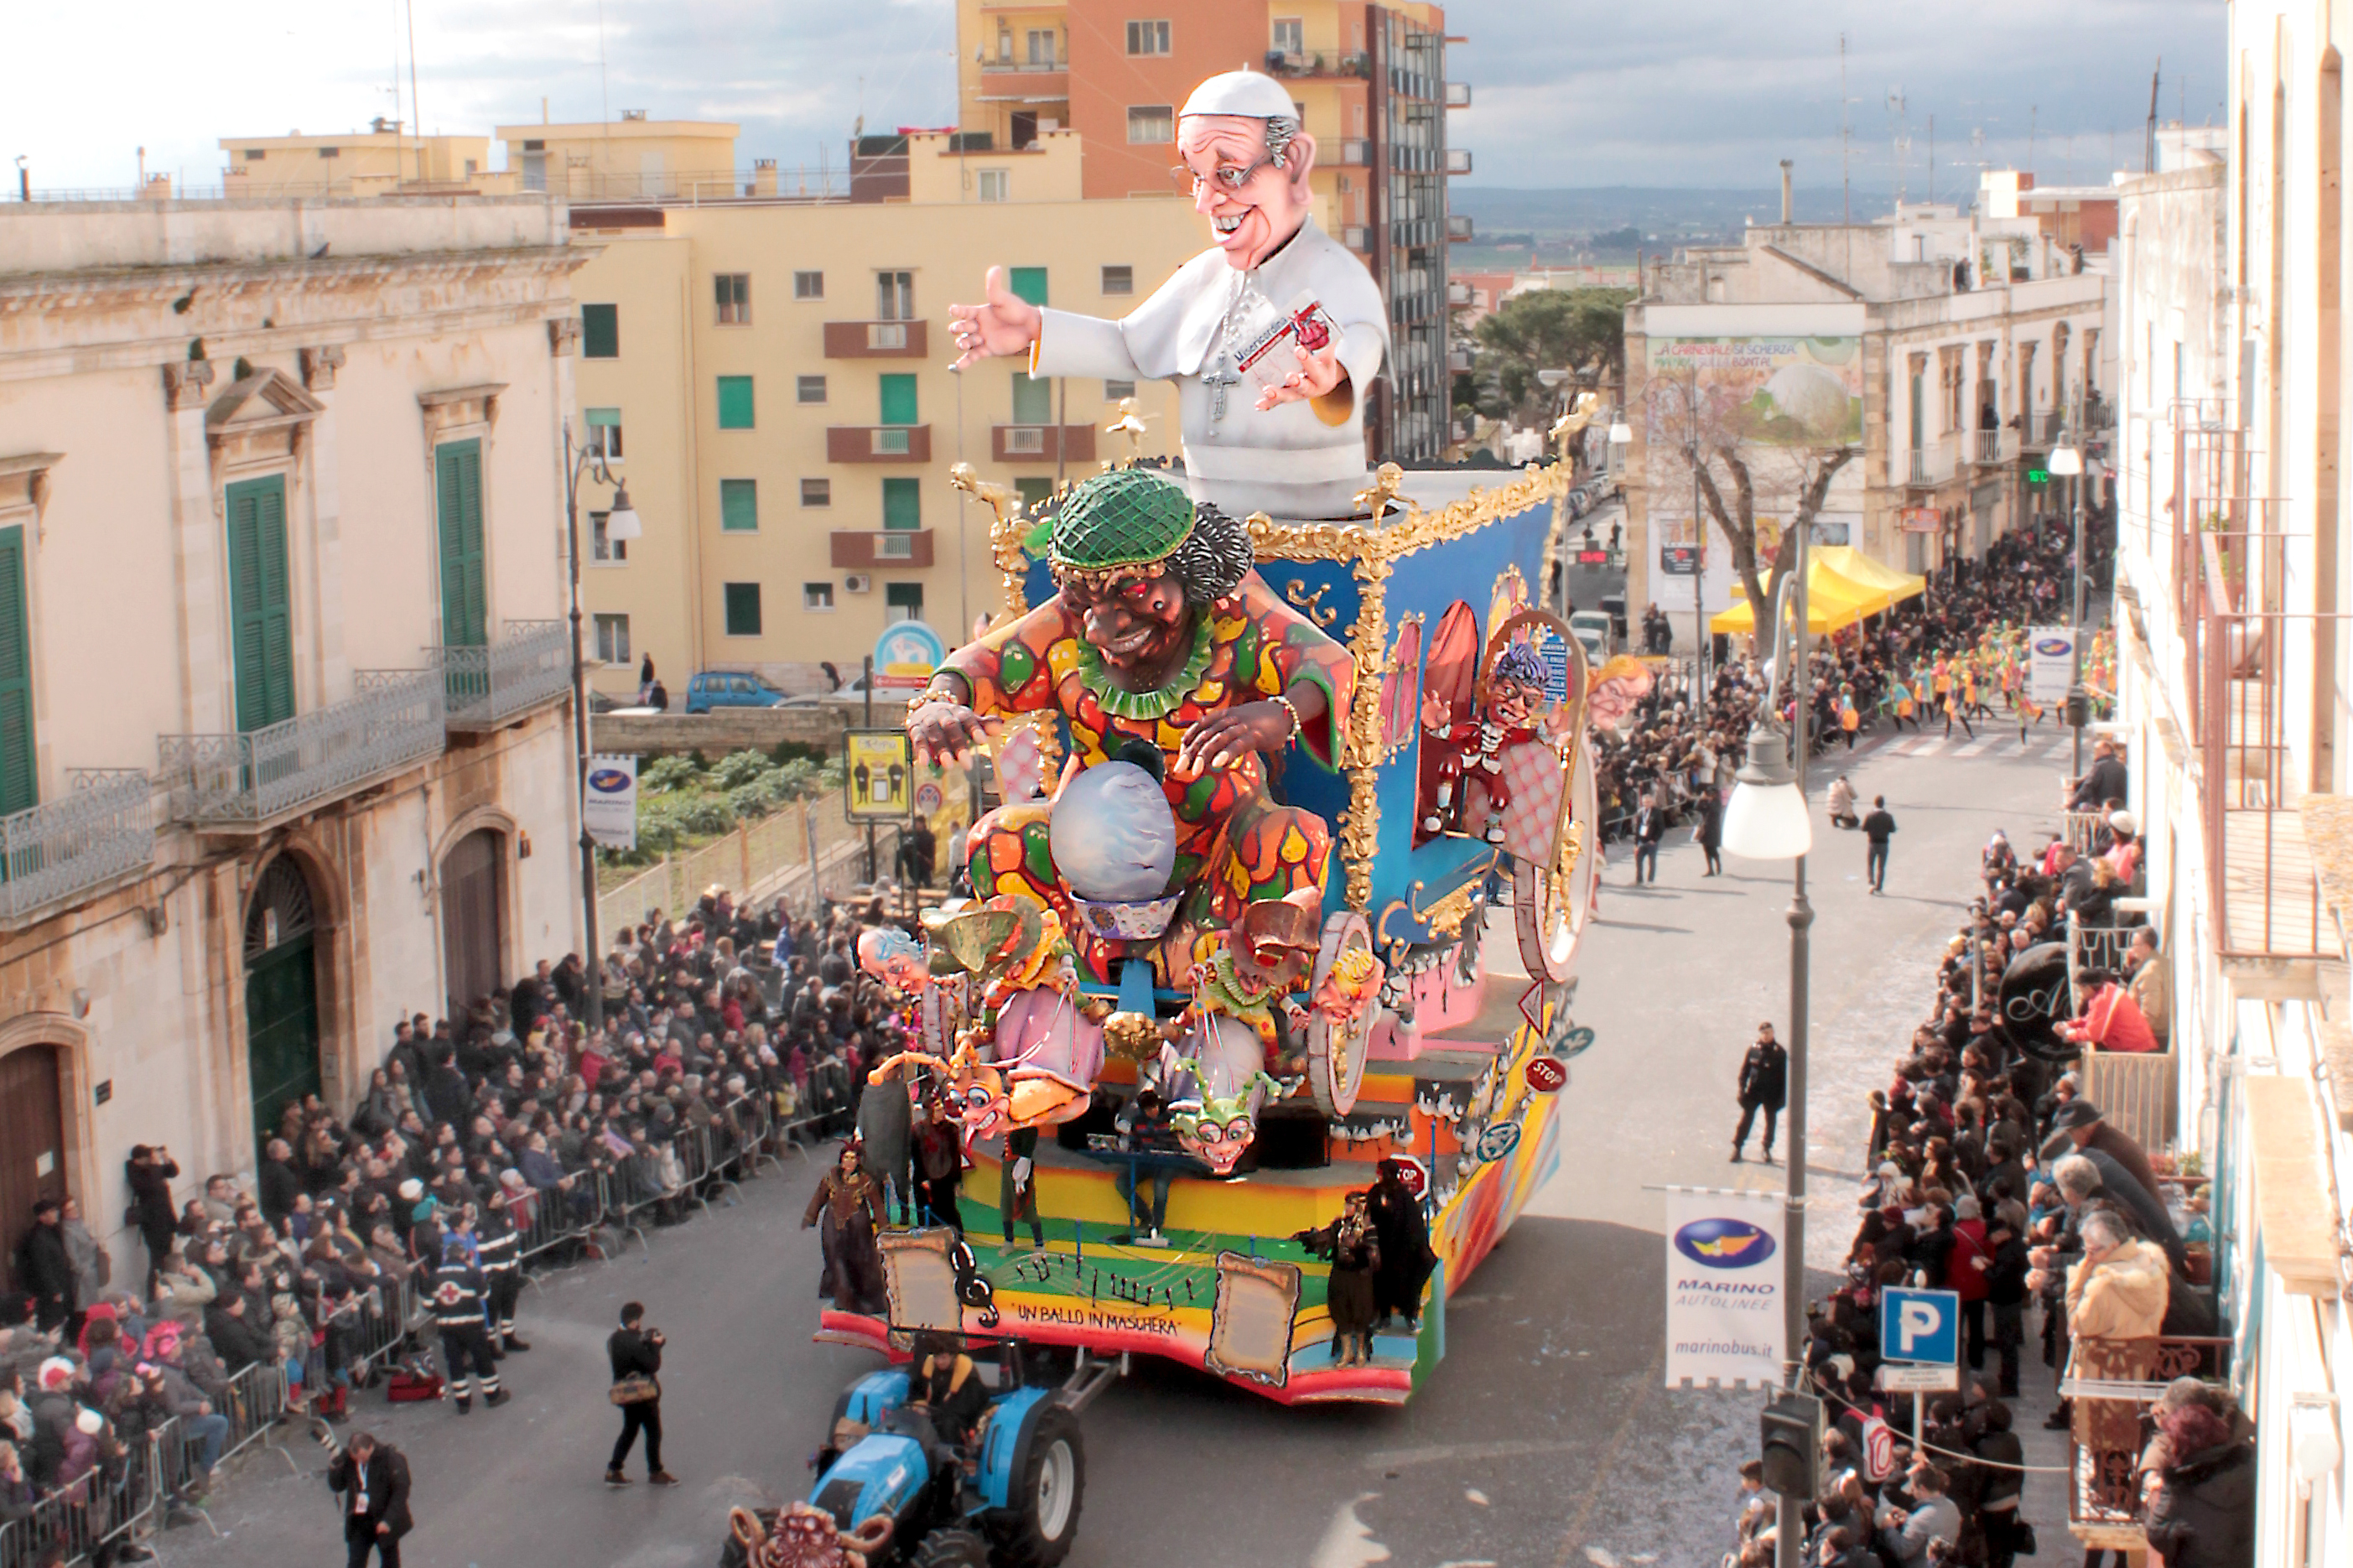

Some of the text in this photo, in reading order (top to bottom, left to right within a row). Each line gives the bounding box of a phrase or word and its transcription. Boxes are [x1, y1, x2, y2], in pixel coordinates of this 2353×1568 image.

[1671, 345, 1731, 355] CARNEVALE
[1734, 345, 1743, 355] SI
[1533, 1062, 1562, 1084] STOP
[1677, 1280, 1775, 1295] MARINO
[1675, 1295, 1773, 1311] AUTOLINEE
[1041, 1306, 1083, 1325] BALLO
[1089, 1311, 1104, 1328] IN
[1900, 1300, 1941, 1352] P
[1675, 1338, 1773, 1358] marinobus.it
